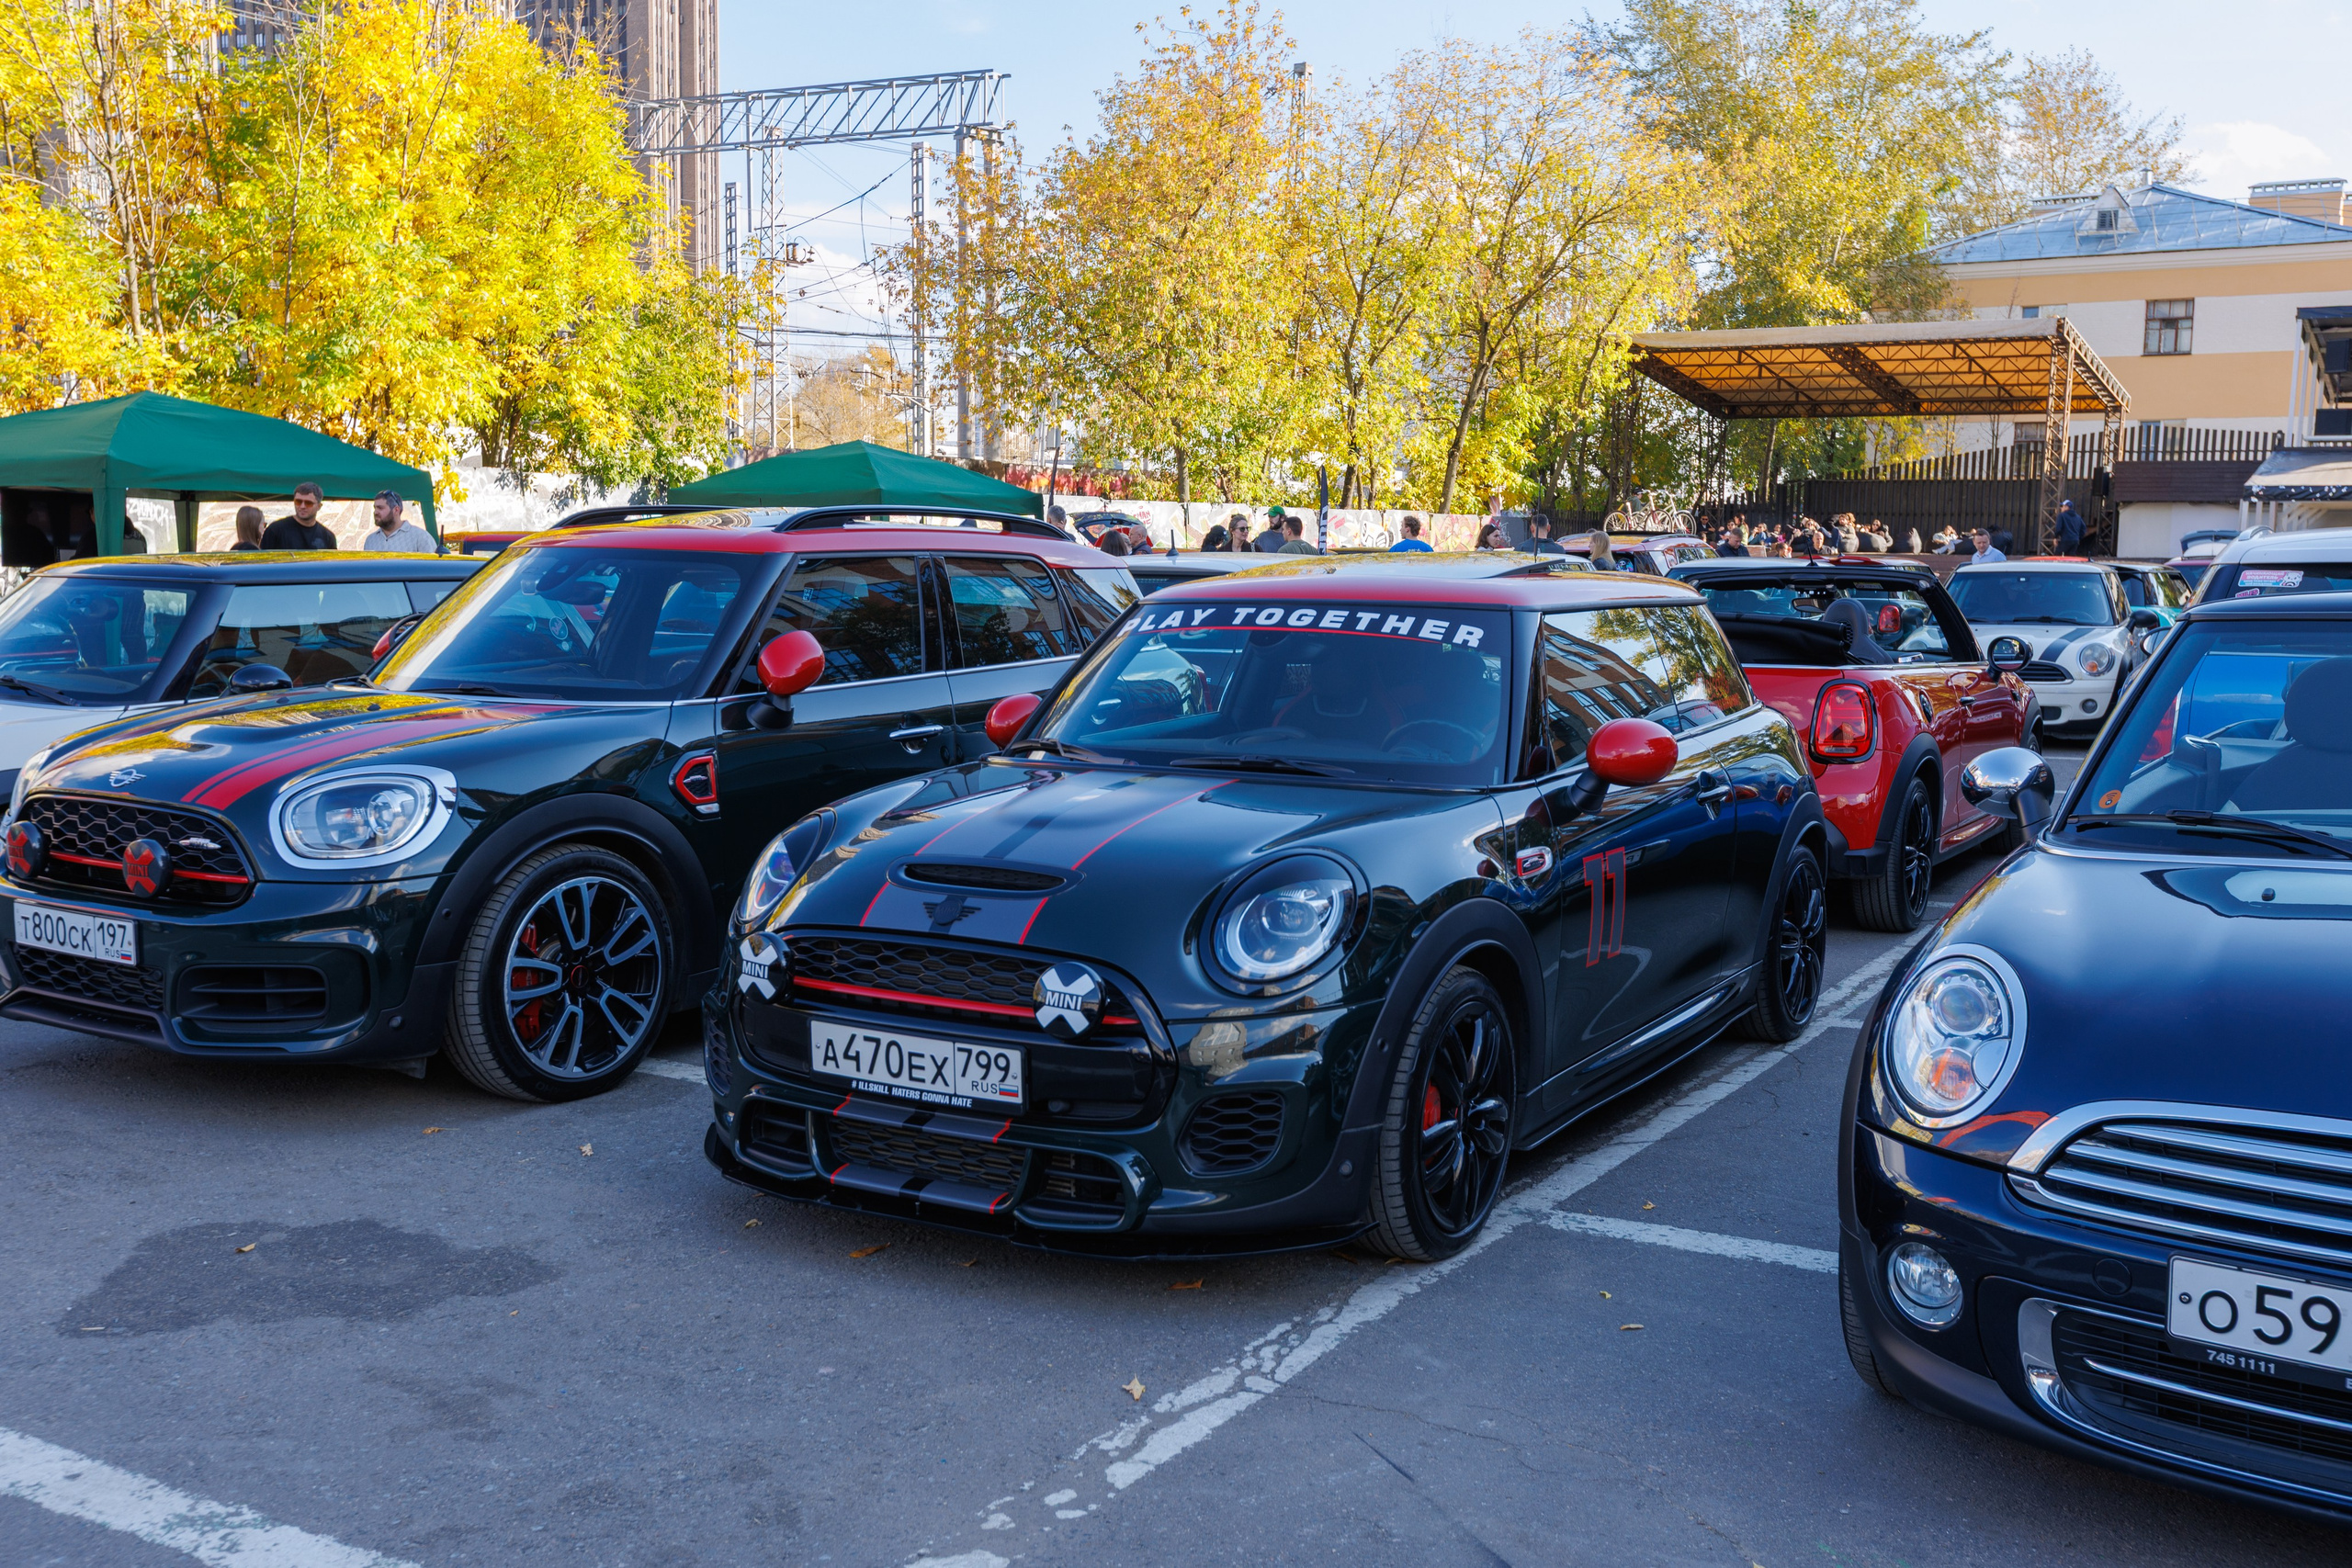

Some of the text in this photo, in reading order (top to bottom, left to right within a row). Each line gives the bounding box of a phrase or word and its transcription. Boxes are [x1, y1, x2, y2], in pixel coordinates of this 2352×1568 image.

[1116, 607, 1485, 648] PLAY TOGETHER
[126, 863, 149, 877] MINI
[1582, 846, 1626, 968] 11
[96, 921, 127, 948] 197
[105, 947, 120, 959] RUS
[741, 960, 769, 979] MINI
[1046, 990, 1082, 1011] MINI
[956, 1047, 1011, 1083] 799
[891, 1087, 921, 1100] HATERS
[922, 1091, 950, 1104] GONNA
[951, 1096, 973, 1108] HATE
[971, 1080, 998, 1095] RUS
[2207, 1349, 2235, 1366] 745
